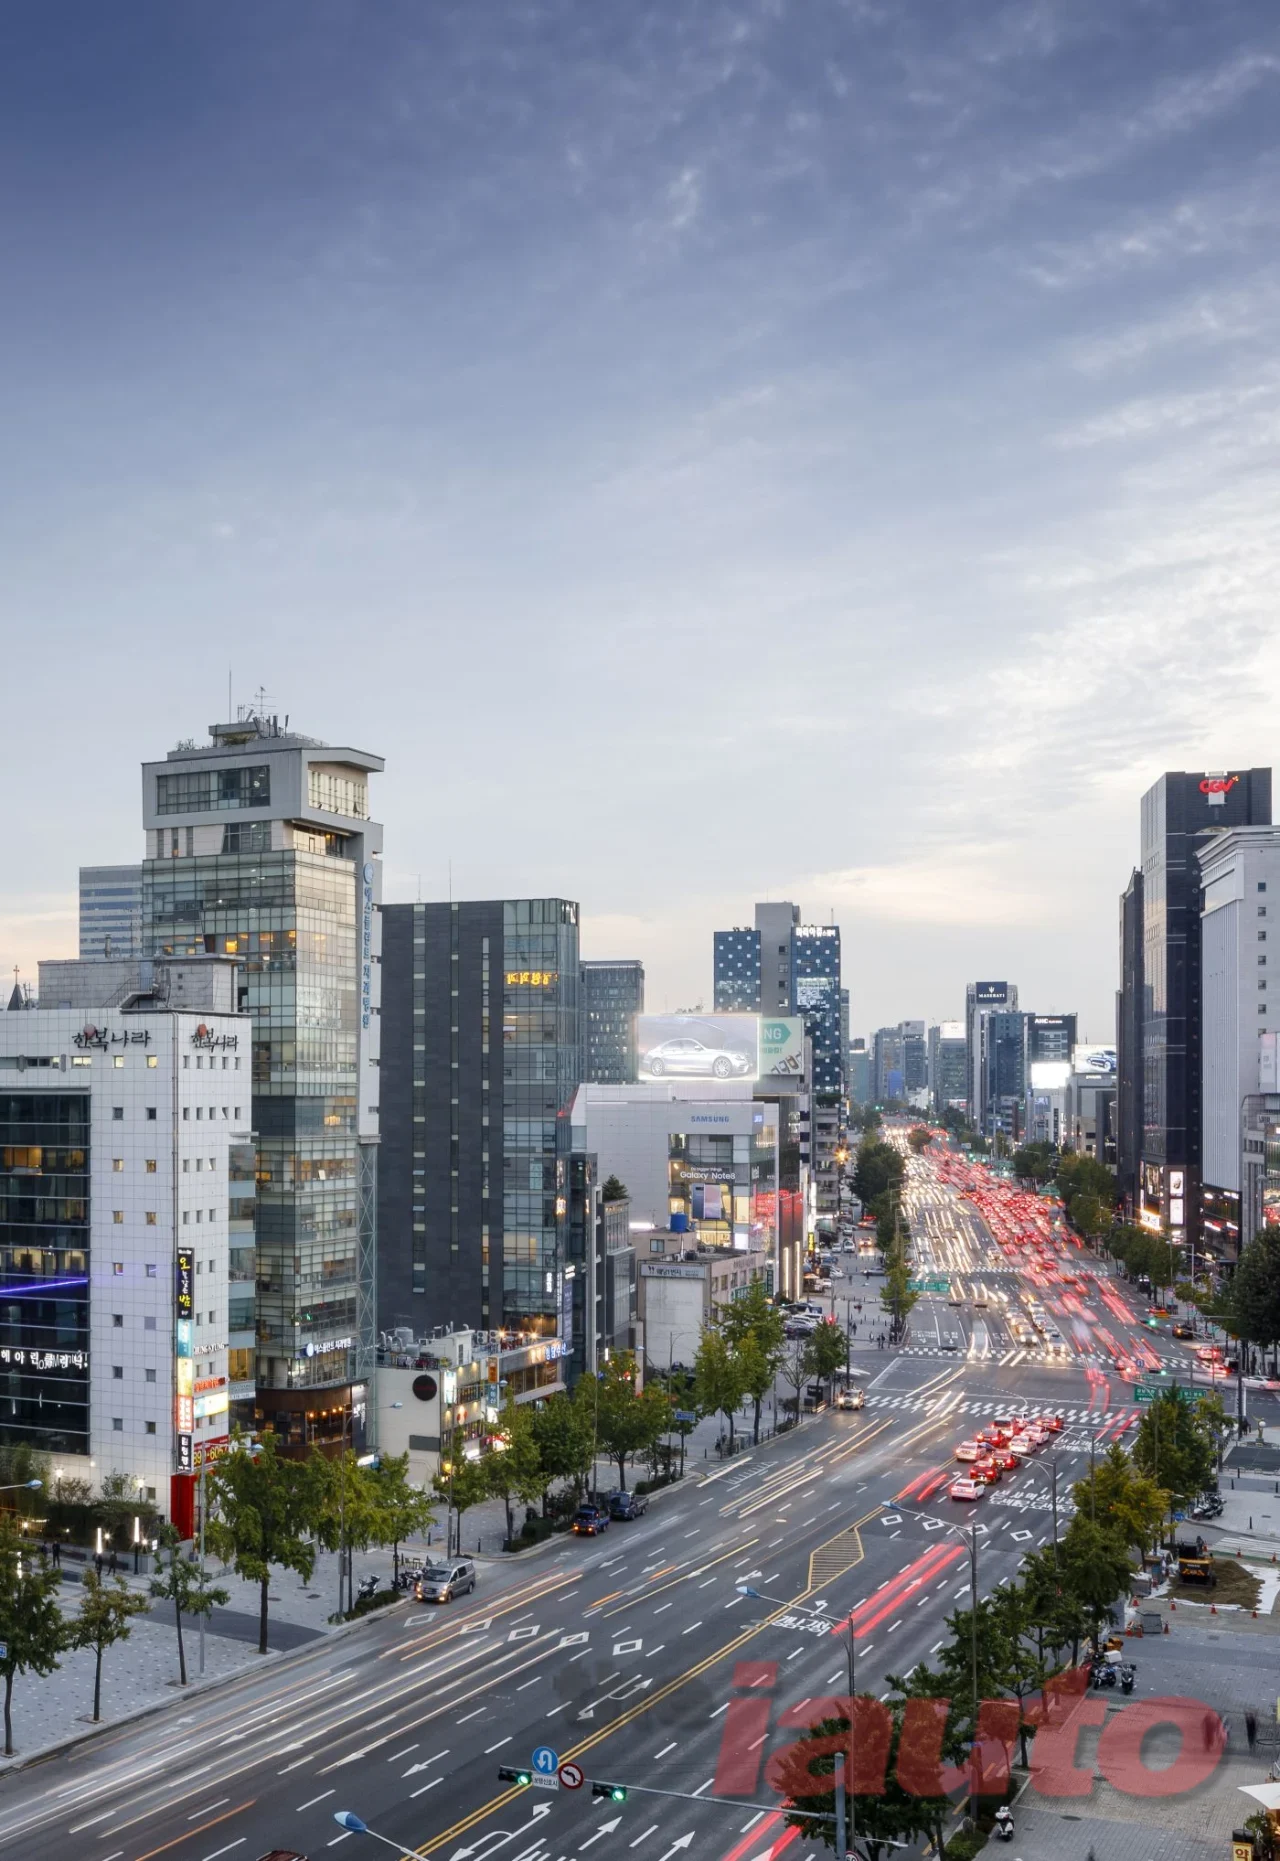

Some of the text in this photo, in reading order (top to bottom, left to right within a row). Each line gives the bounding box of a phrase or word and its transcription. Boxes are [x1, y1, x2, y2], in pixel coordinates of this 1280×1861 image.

[1198, 778, 1236, 794] CGV
[72, 1027, 151, 1053] 한복나라
[191, 1027, 239, 1053] 한복나라
[691, 1115, 730, 1123] SAMSUNG
[680, 1171, 736, 1180] Galaxy Note8
